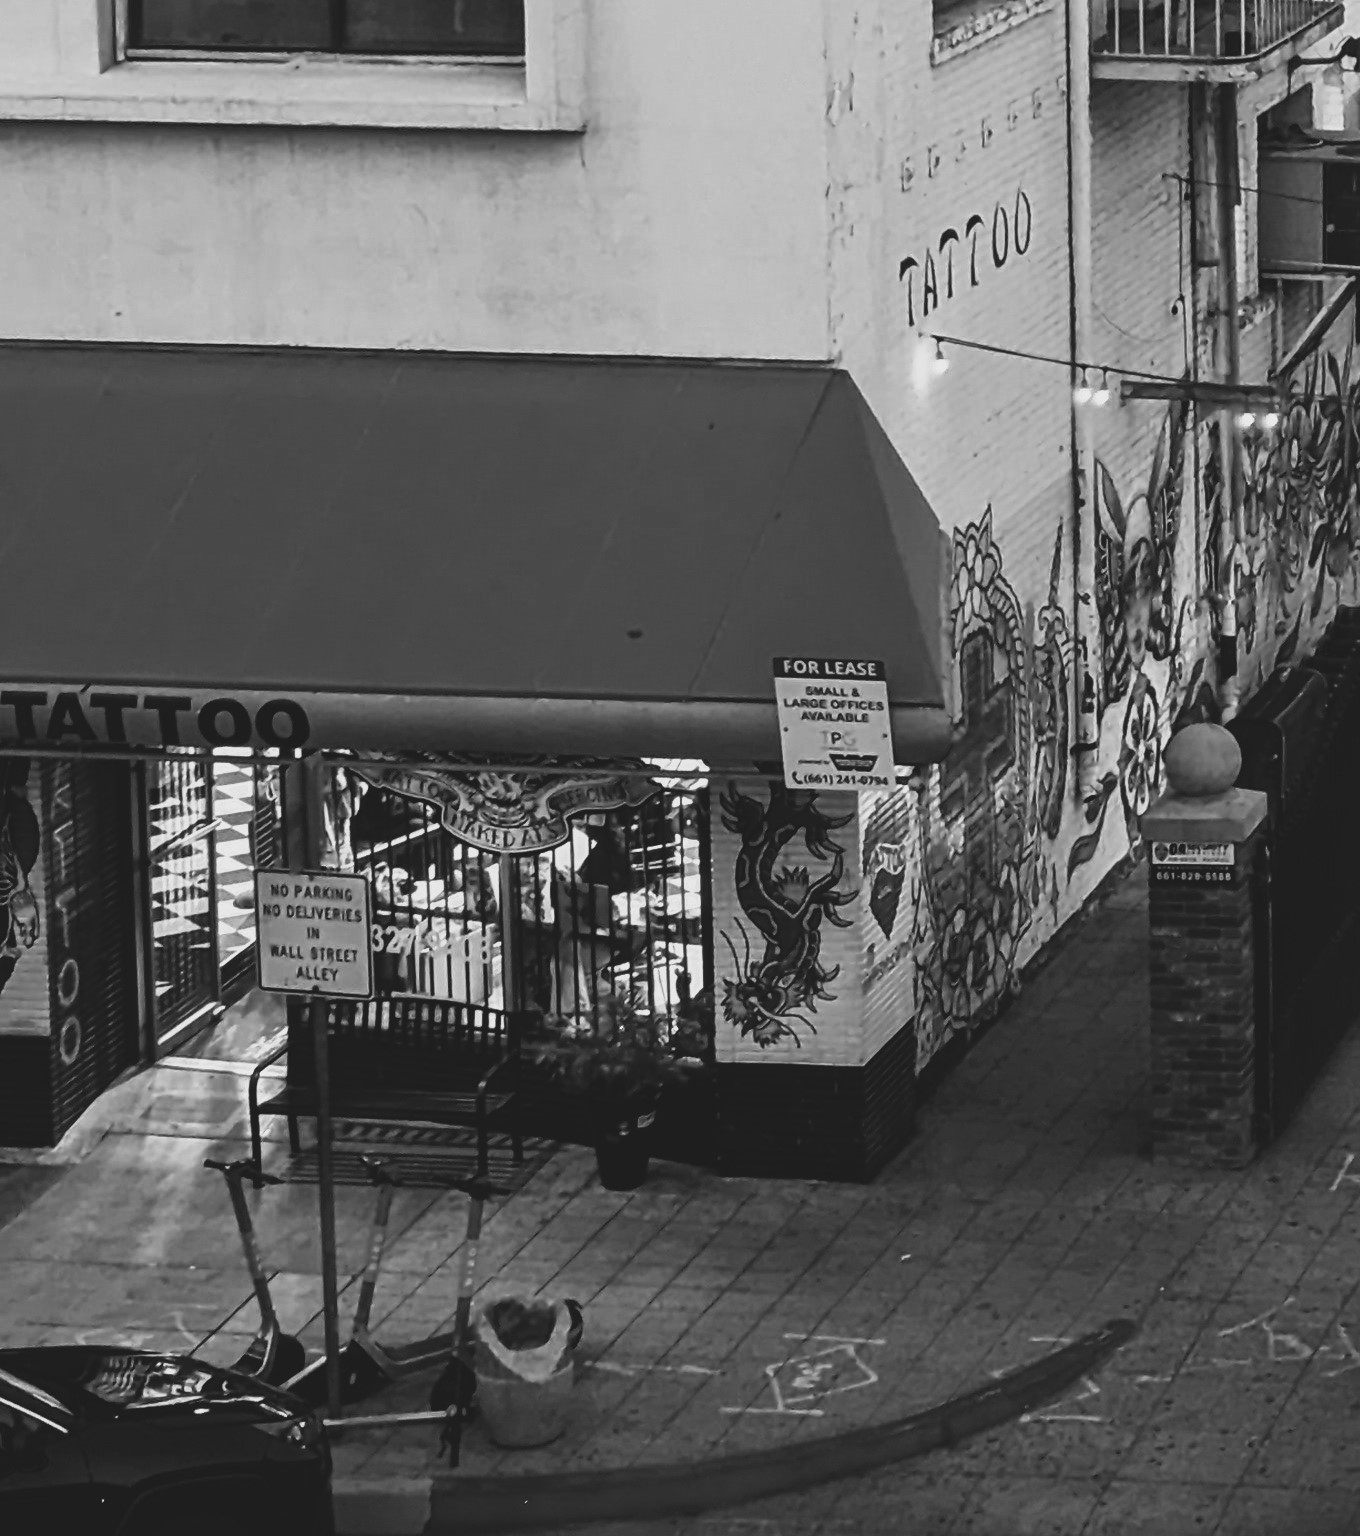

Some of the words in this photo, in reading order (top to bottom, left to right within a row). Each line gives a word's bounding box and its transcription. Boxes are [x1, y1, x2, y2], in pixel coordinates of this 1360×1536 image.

[898, 183, 1032, 328] TATTOO
[783, 660, 820, 675] FOR
[824, 662, 878, 677] LEASE
[805, 685, 849, 698] SMALL
[851, 687, 861, 698] &
[783, 697, 828, 710] LARGE
[830, 699, 885, 712] OFFICES
[0, 691, 311, 747] TATTOO
[800, 711, 869, 724] AVAILABLE
[803, 773, 834, 786] (661)
[270, 884, 289, 898] NO
[293, 885, 353, 902] PARKING
[262, 904, 281, 917] NO
[286, 904, 363, 923] DELIVERIES
[306, 926, 320, 940] IN
[269, 945, 304, 960] WALL
[310, 946, 358, 963] STREET
[296, 965, 338, 982] ALLEY
